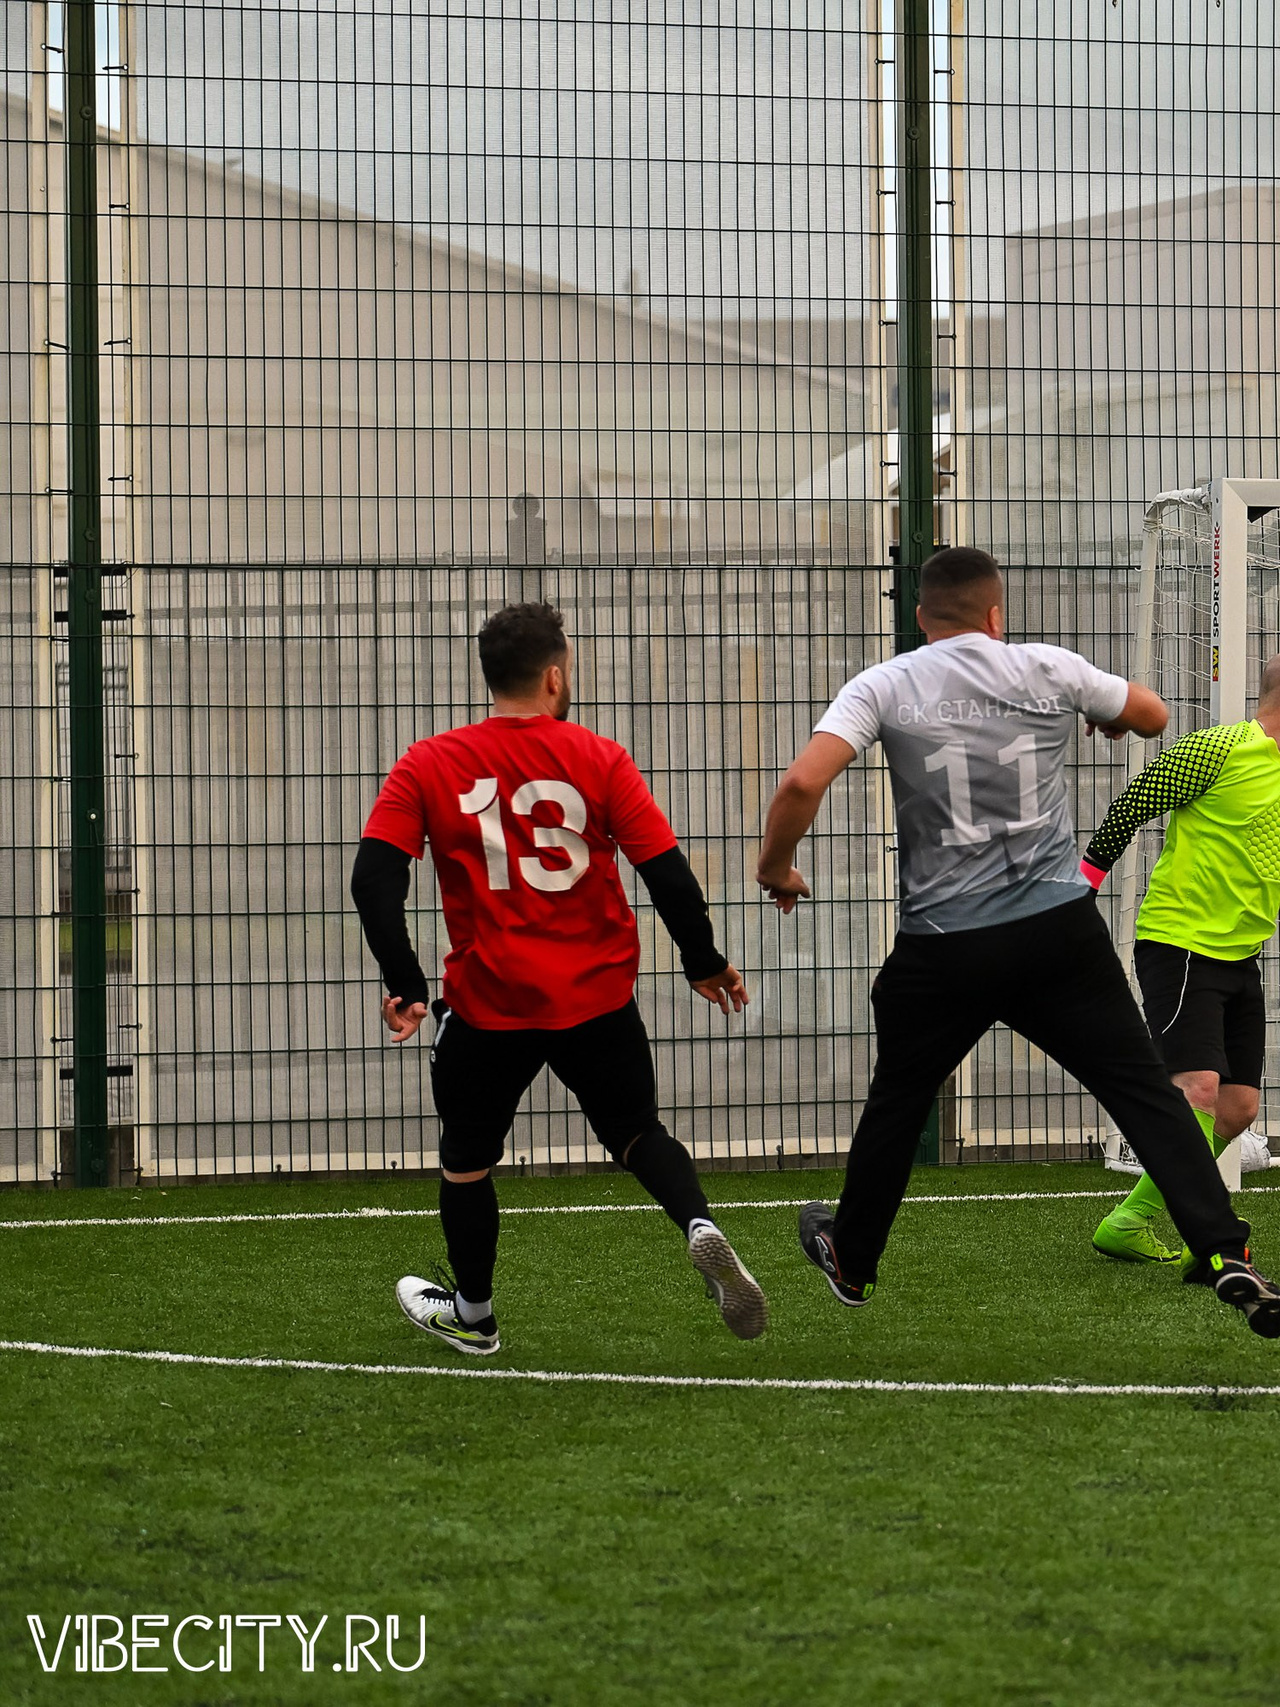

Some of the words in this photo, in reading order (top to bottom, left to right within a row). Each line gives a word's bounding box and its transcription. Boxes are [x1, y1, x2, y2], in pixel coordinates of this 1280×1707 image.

[1212, 525, 1221, 638] SPORTWERK
[897, 703, 930, 725] СК
[458, 777, 590, 891] 13
[924, 733, 1052, 847] 11
